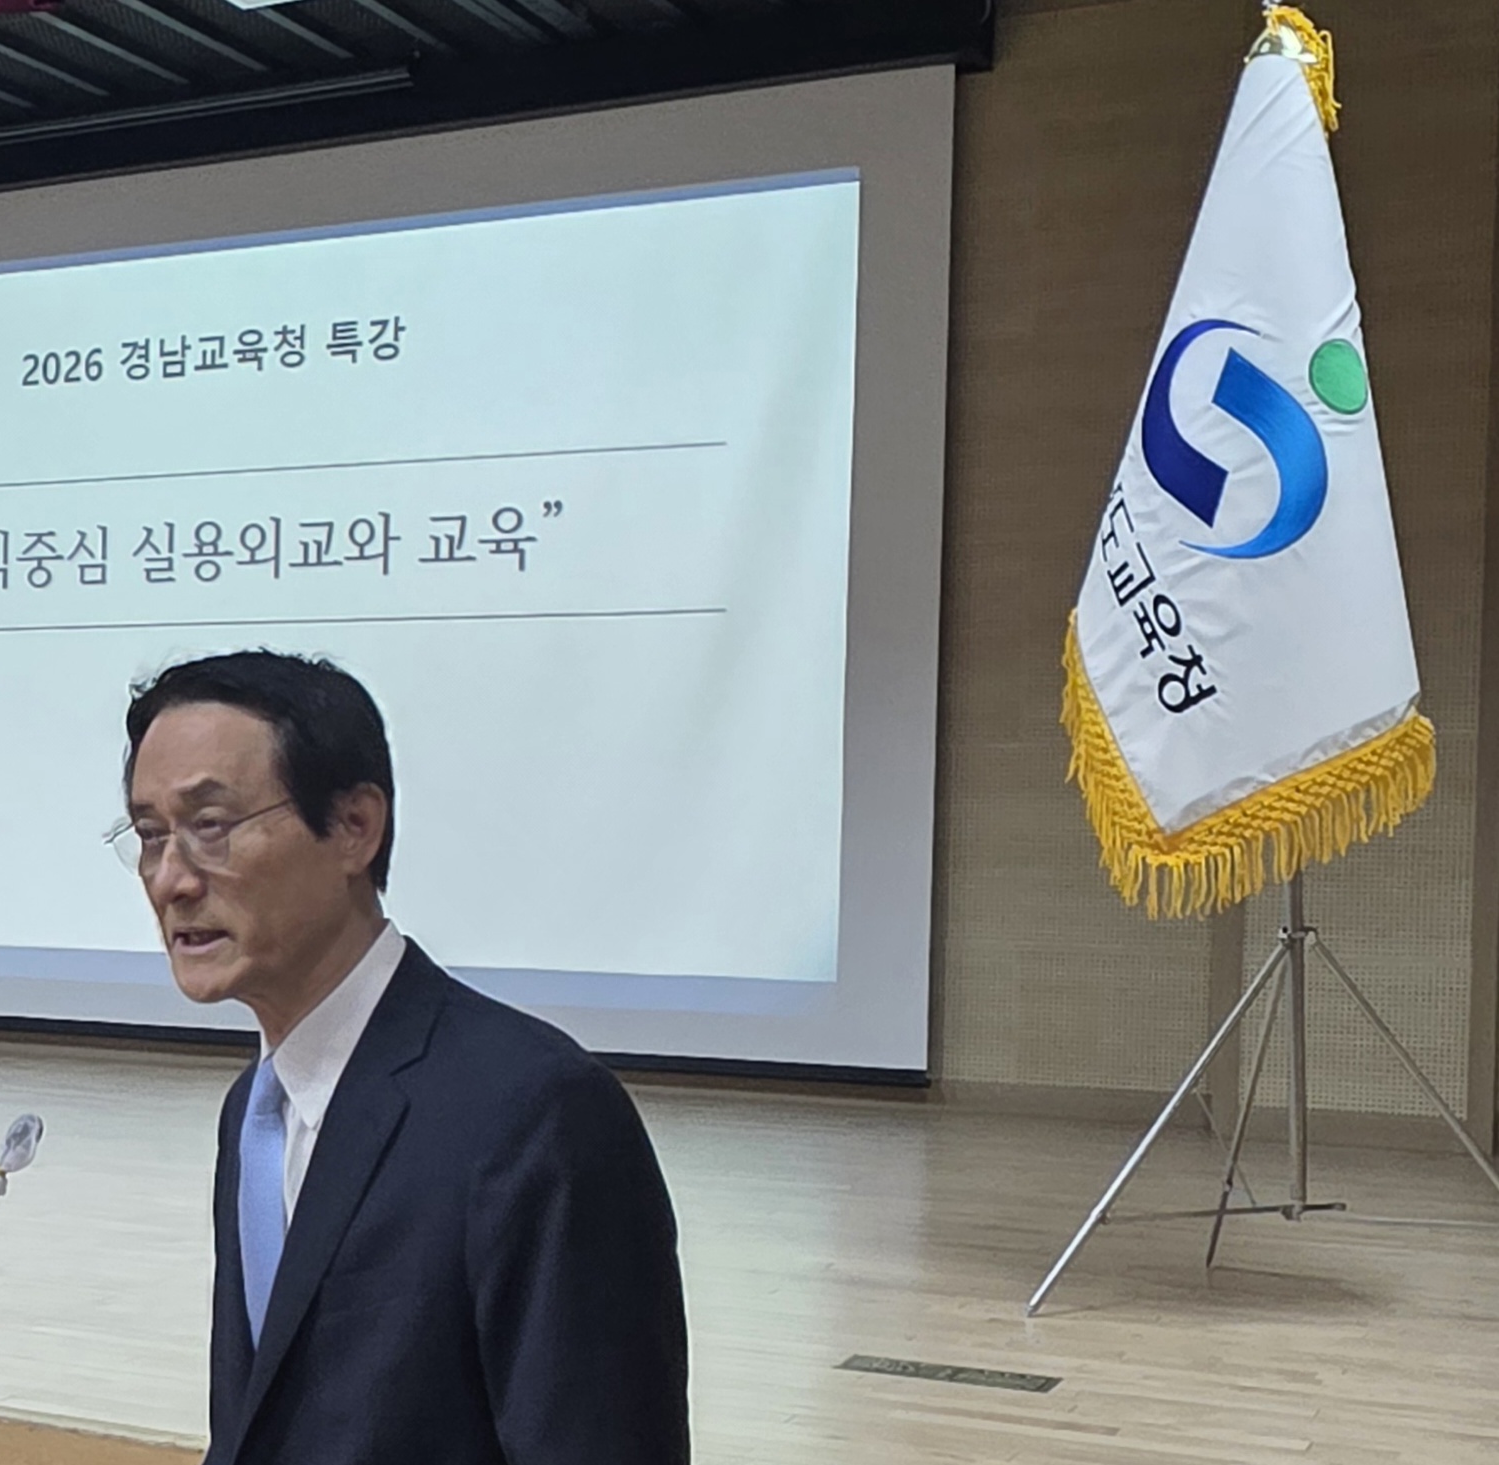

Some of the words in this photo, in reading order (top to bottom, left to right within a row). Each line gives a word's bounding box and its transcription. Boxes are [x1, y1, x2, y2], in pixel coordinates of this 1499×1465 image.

[21, 346, 104, 387] 2026
[119, 322, 307, 381] 경남교육청
[325, 315, 407, 364] 특강
[132, 511, 402, 584] 실용외교와
[417, 499, 564, 573] 교육”
[1101, 481, 1217, 713] 도교육청
